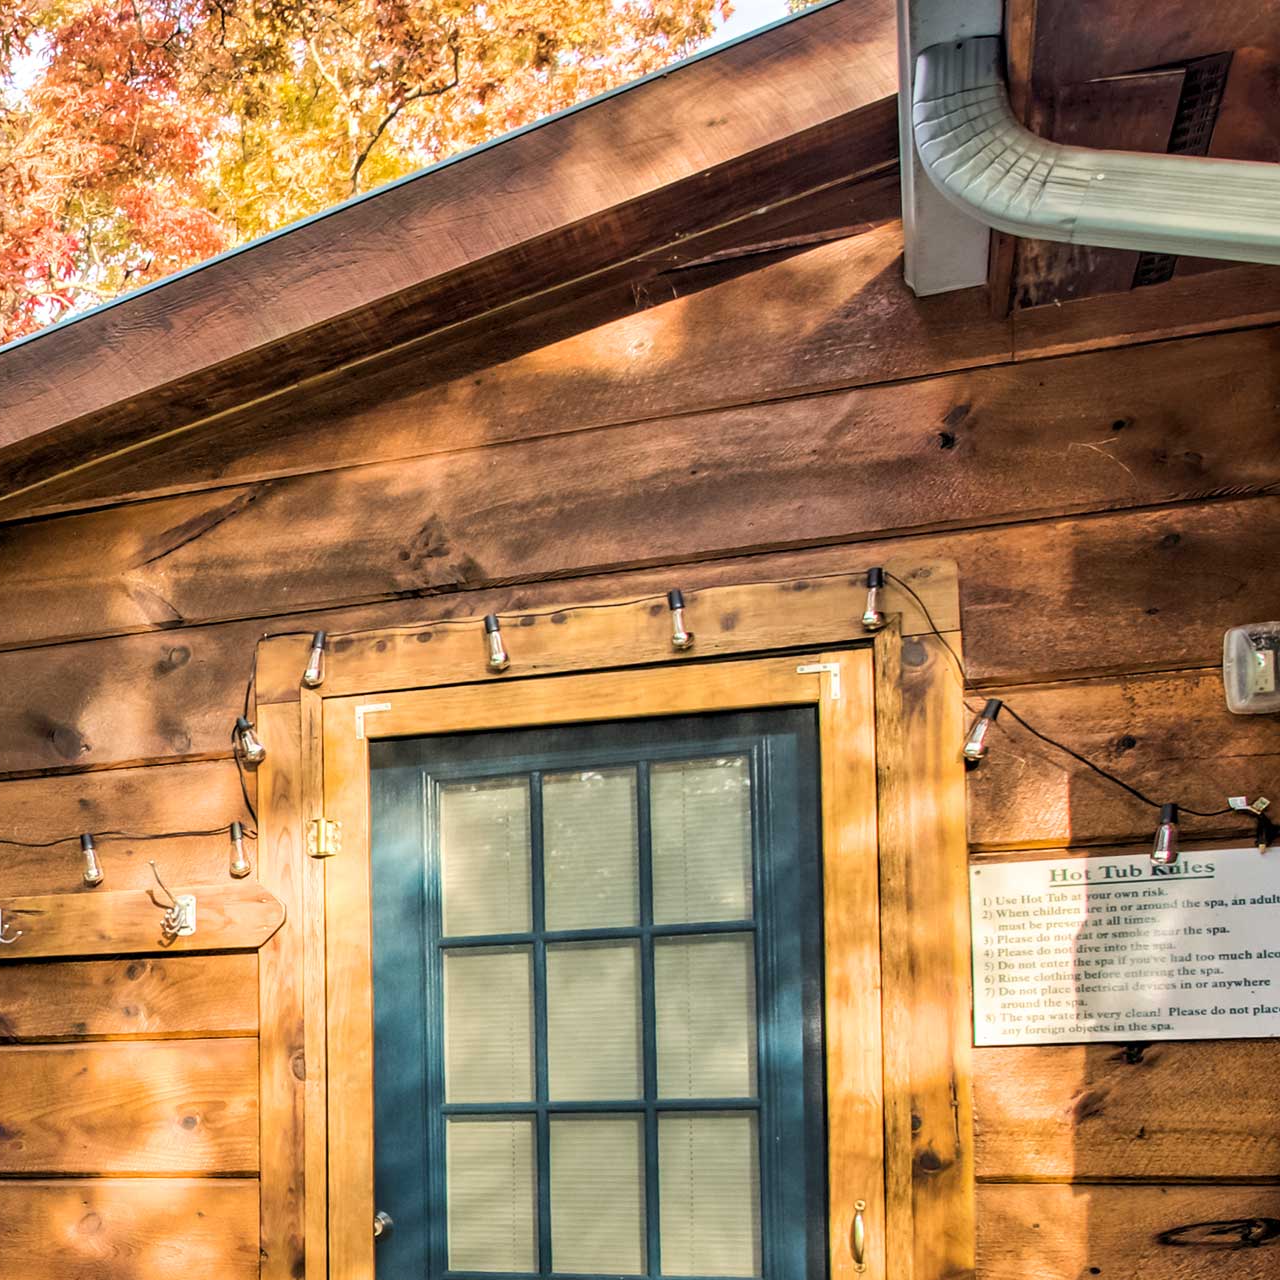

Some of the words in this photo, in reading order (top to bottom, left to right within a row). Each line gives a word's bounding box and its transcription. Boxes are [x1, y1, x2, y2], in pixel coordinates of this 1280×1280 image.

[1049, 868, 1091, 882] Hot
[1098, 864, 1143, 879] Tub
[1151, 861, 1215, 876] Rules
[996, 896, 1017, 906] Use
[1021, 894, 1042, 904] Hot
[1047, 893, 1068, 903] Tub
[1072, 893, 1082, 901] at
[1085, 891, 1111, 902] your
[1114, 889, 1139, 898] own
[1142, 887, 1168, 897] risk.
[996, 908, 1029, 918] When
[1033, 906, 1080, 917] children
[1106, 903, 1117, 912] in
[1136, 900, 1178, 911] around
[1182, 899, 1200, 908] the
[1204, 899, 1228, 909] spa,
[1231, 898, 1246, 906] an
[998, 922, 1025, 931] must
[1029, 920, 1042, 929] be
[1046, 919, 1088, 930] present
[1092, 918, 1102, 927] at
[1106, 916, 1120, 926] all
[1124, 915, 1160, 925] times.
[997, 934, 1032, 944] Please
[1036, 933, 1050, 942] do
[1054, 932, 1073, 941] not
[1076, 931, 1093, 940] eat
[1111, 928, 1150, 938] smoke
[1183, 926, 1202, 935] the
[1206, 926, 1230, 937] spa.
[997, 947, 1033, 957] Please
[1036, 946, 1051, 955] do
[1054, 945, 1074, 954] not
[1076, 944, 1100, 953] dive
[1104, 943, 1127, 952] into
[1130, 941, 1150, 950] the
[998, 961, 1015, 970] Do
[1018, 960, 1036, 969] not
[1040, 959, 1070, 968] enter
[1073, 957, 1091, 967] the
[1094, 957, 1114, 967] spa
[1118, 956, 1126, 965] if
[1129, 955, 1166, 966] you've
[1170, 953, 1192, 963] had
[1196, 952, 1214, 961] too
[1218, 950, 1252, 960] much
[998, 973, 1031, 983] Rinse
[1035, 971, 1081, 982] clothing
[1084, 970, 1121, 979] before
[1124, 968, 1174, 978] entering
[1177, 966, 1196, 976] the
[1200, 967, 1224, 977] spa.
[999, 987, 1016, 996] Do
[1020, 986, 1038, 995] not
[1041, 985, 1071, 996] place
[1075, 982, 1128, 993] electrical
[1132, 981, 1177, 991] devices
[1181, 980, 1192, 989] in
[1196, 981, 1208, 989] or
[1212, 977, 1271, 989] anywhere
[1001, 999, 1040, 1009] around
[1044, 998, 1061, 1007] the
[1065, 999, 1088, 1009] spa.
[1001, 1012, 1023, 1022] The
[1026, 1012, 1045, 1022] spa
[1049, 1010, 1081, 1020] water
[1084, 1010, 1094, 1019] is
[1097, 1009, 1122, 1020] very
[1125, 1007, 1161, 1018] clean!
[1168, 1007, 1207, 1016] Please
[1210, 1006, 1226, 1015] do
[1229, 1006, 1249, 1014] not
[1002, 1026, 1022, 1036] any
[1025, 1024, 1065, 1035] foreign
[1068, 1023, 1110, 1034] objects
[1114, 1022, 1125, 1032] in
[1128, 1022, 1147, 1032] the
[1151, 1022, 1174, 1032] spa.
